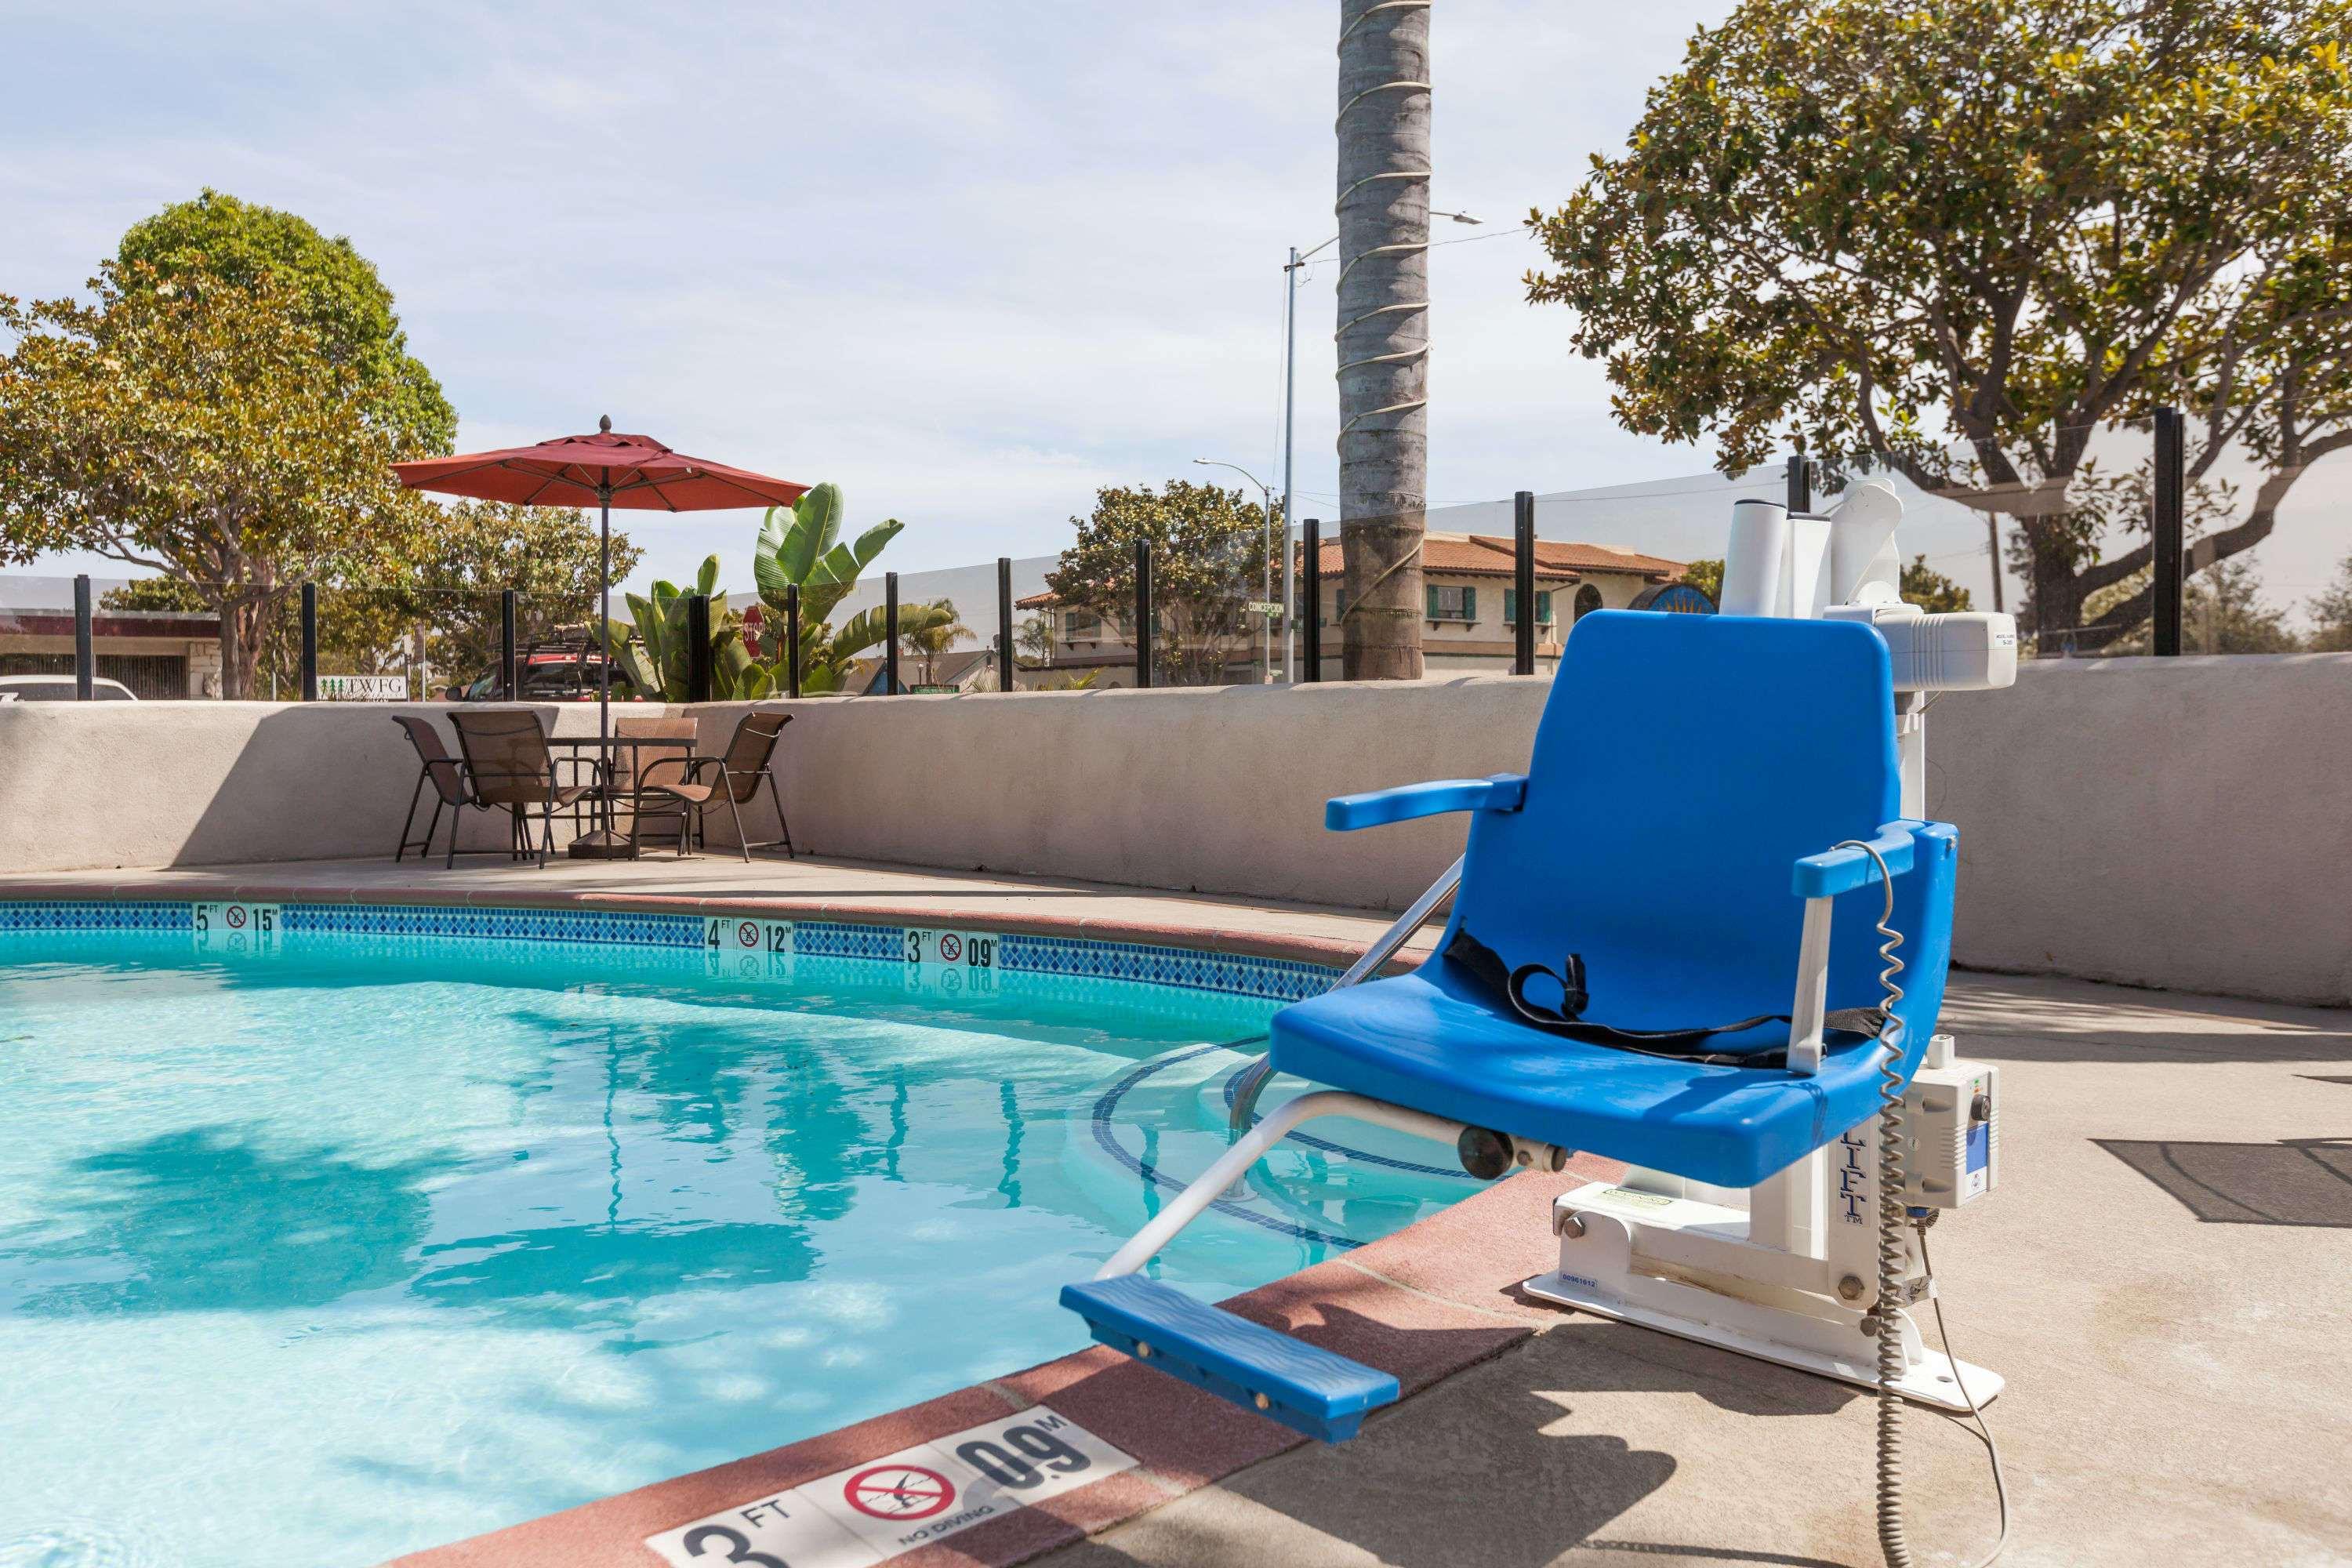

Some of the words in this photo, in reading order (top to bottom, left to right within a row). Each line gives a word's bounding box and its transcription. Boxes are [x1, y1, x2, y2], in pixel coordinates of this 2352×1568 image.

[1248, 602, 1283, 613] CONCEPCION
[744, 622, 764, 641] STOP
[347, 678, 401, 693] TWFG
[197, 905, 209, 931] 5
[209, 905, 218, 913] FT
[708, 919, 720, 950] 4
[721, 920, 731, 929] FT
[908, 931, 921, 963] 3
[922, 931, 932, 942] FT
[683, 1524, 792, 1568] 3
[739, 1498, 790, 1528] FT
[956, 1425, 1091, 1490] 0.9
[898, 1530, 929, 1545] NO
[931, 1505, 996, 1533] DIVING
